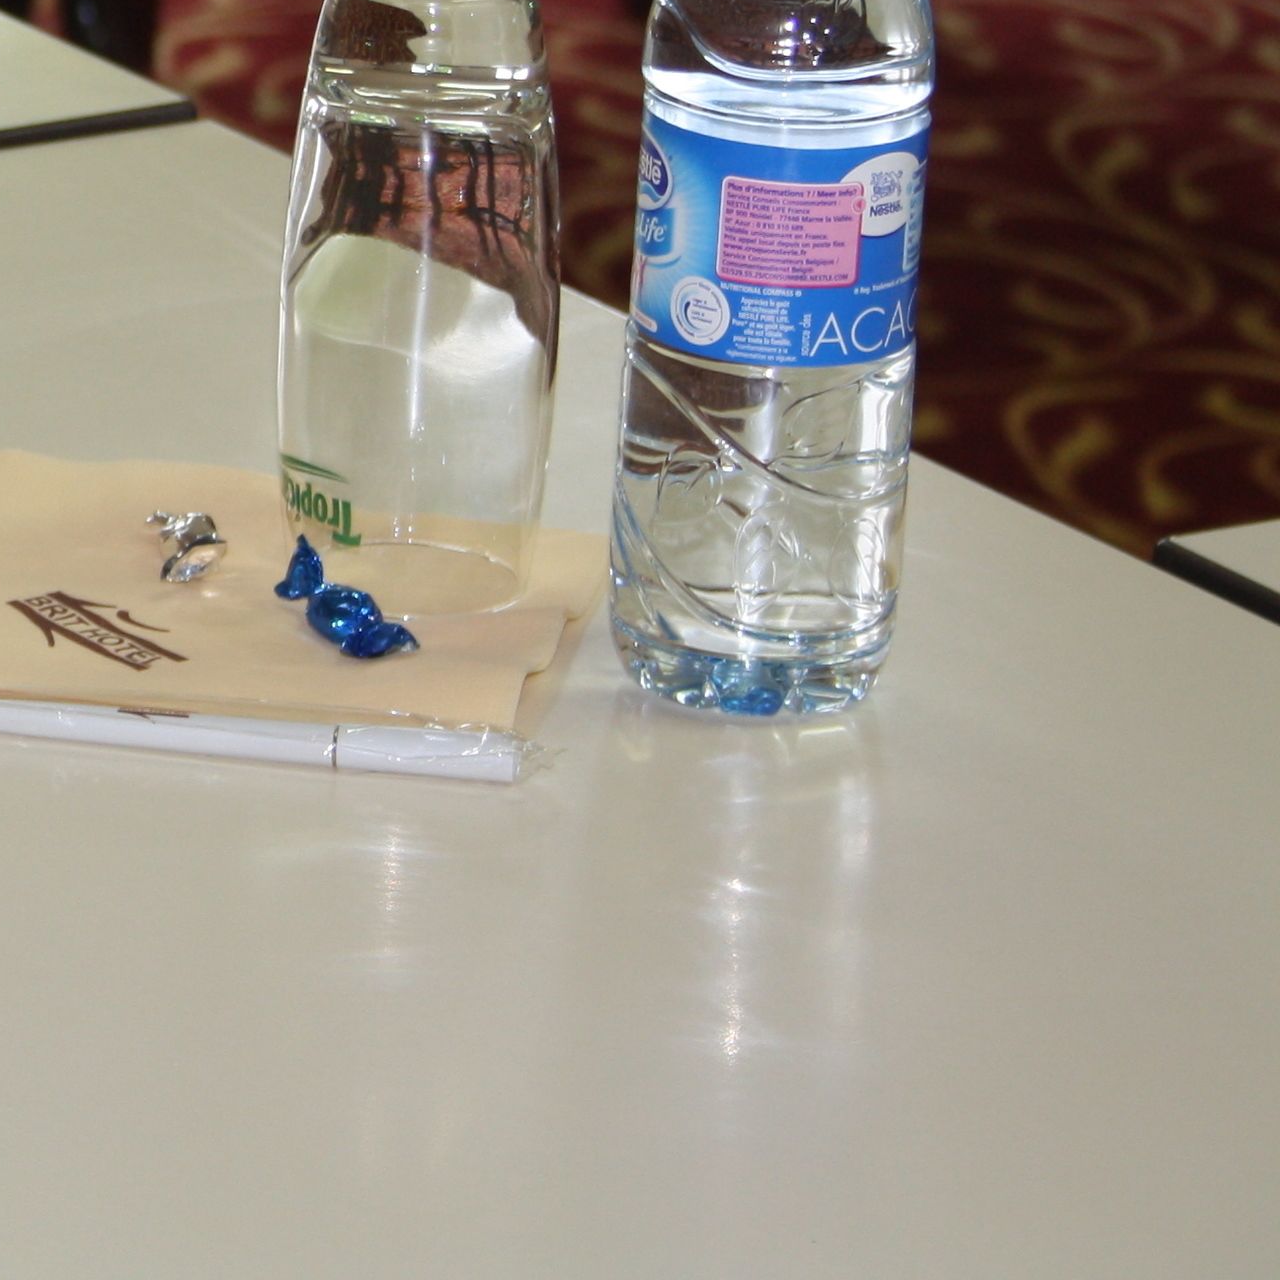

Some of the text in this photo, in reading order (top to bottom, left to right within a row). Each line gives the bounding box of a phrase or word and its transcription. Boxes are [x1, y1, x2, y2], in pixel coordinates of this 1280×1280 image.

[638, 213, 665, 243] Life
[23, 596, 162, 667] BRIT HOTEL
